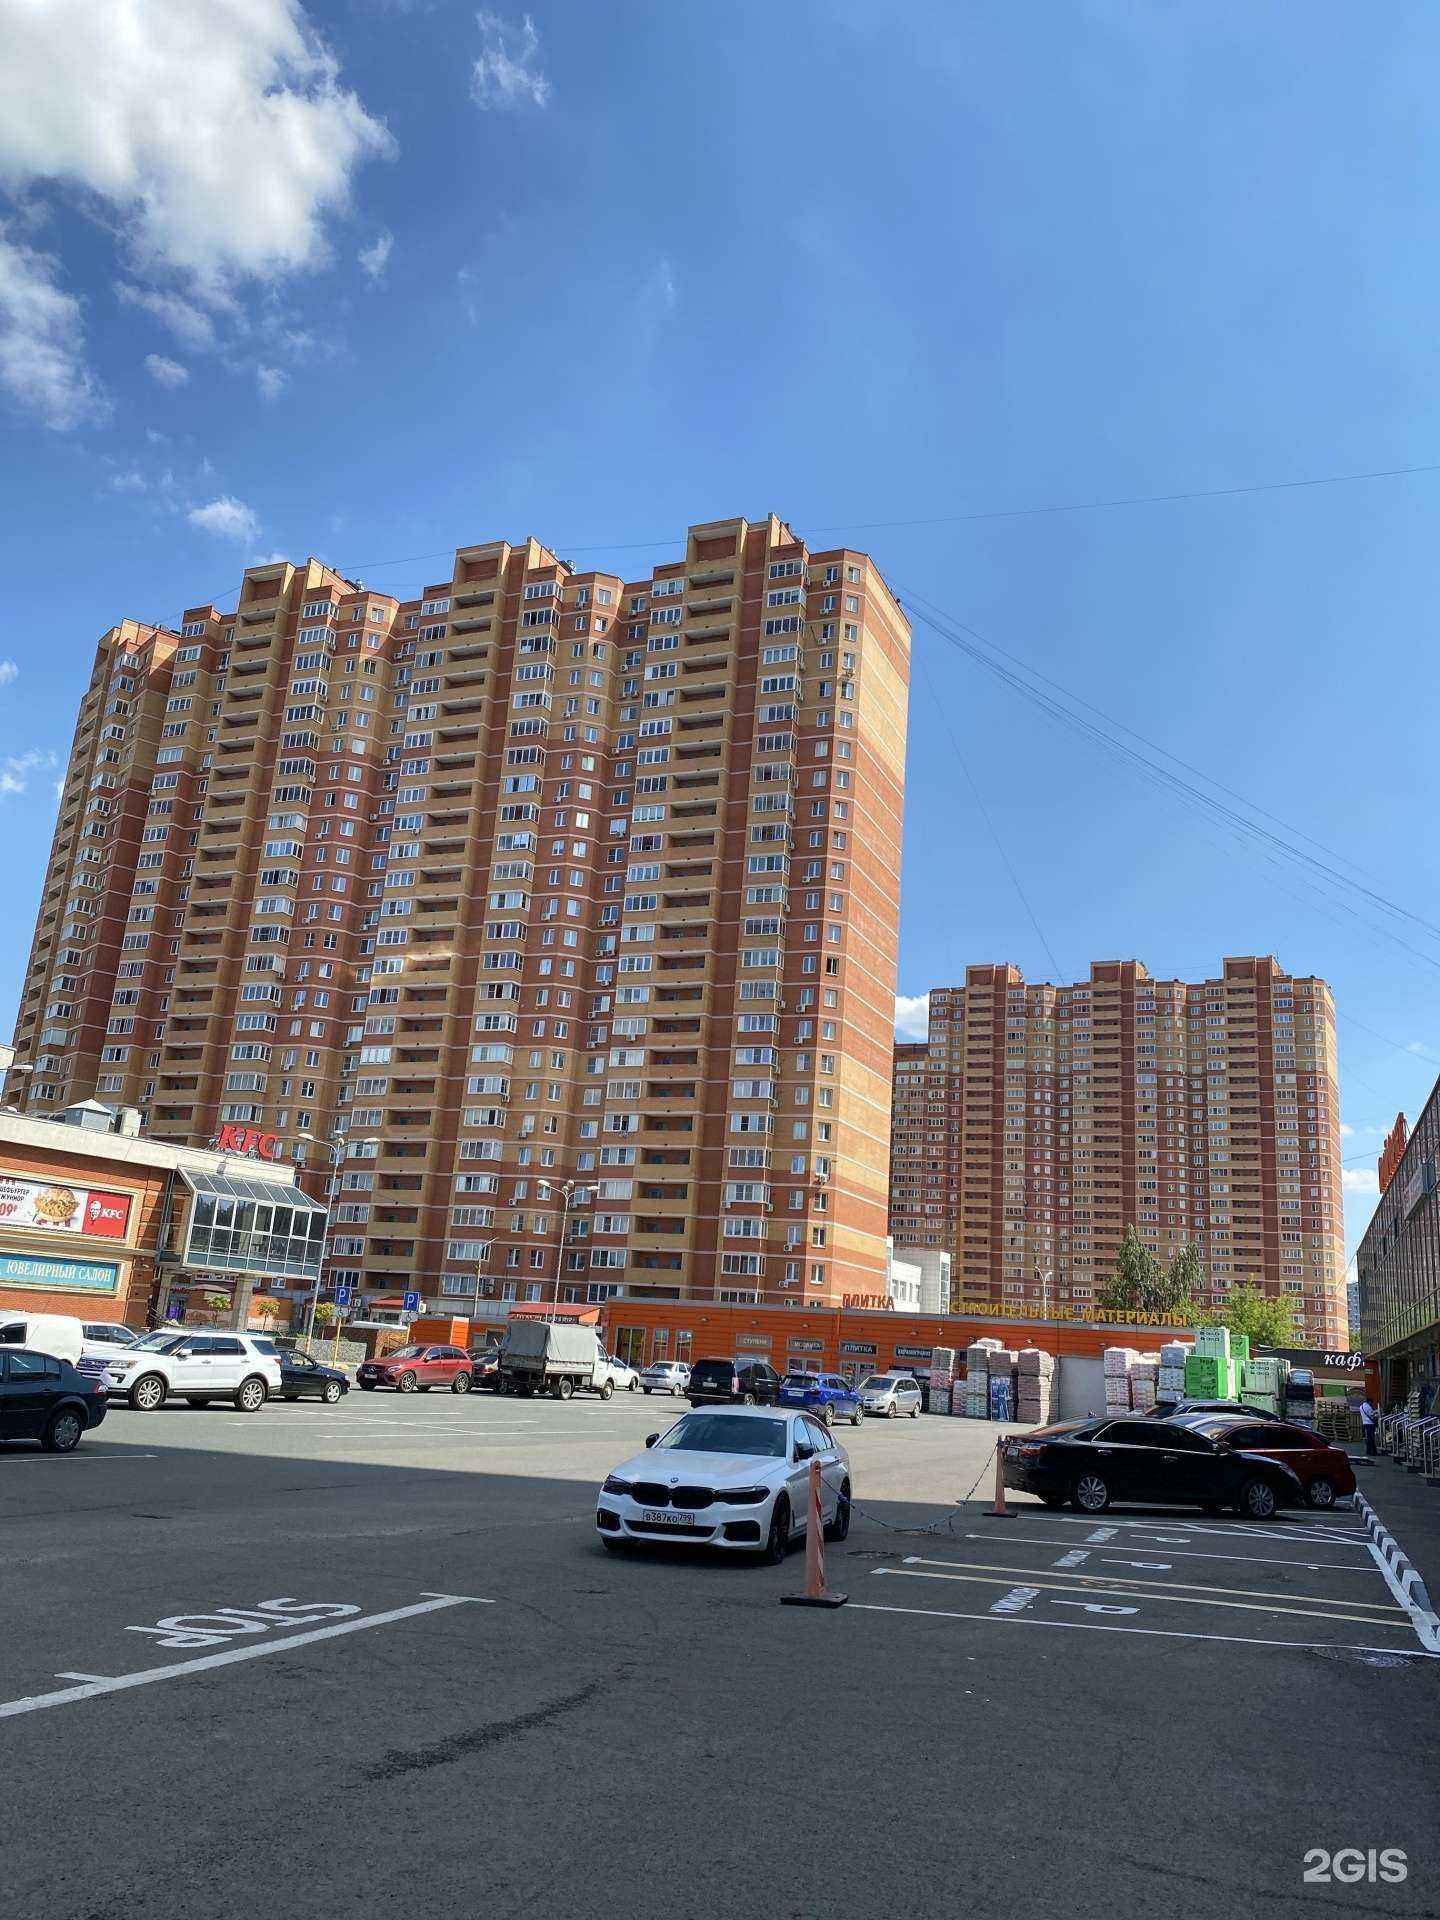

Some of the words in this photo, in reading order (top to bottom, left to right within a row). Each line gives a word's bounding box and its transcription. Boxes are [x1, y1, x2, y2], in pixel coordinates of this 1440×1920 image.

[219, 1124, 278, 1159] KFC
[101, 1208, 124, 1219] KFC
[6, 1260, 76, 1280] ЮВЕЛИРНЫЙ
[78, 1267, 112, 1282] САЛОН
[842, 1293, 895, 1311] ПЛИТКА
[950, 1302, 1074, 1320] СТРОИТЕЛЬНЫЕ
[1082, 1308, 1189, 1327] МАТЕРИАЛЫ
[844, 1344, 873, 1354] ПЛИТКА
[1324, 1352, 1365, 1372] каф
[124, 1597, 362, 1648] STOP
